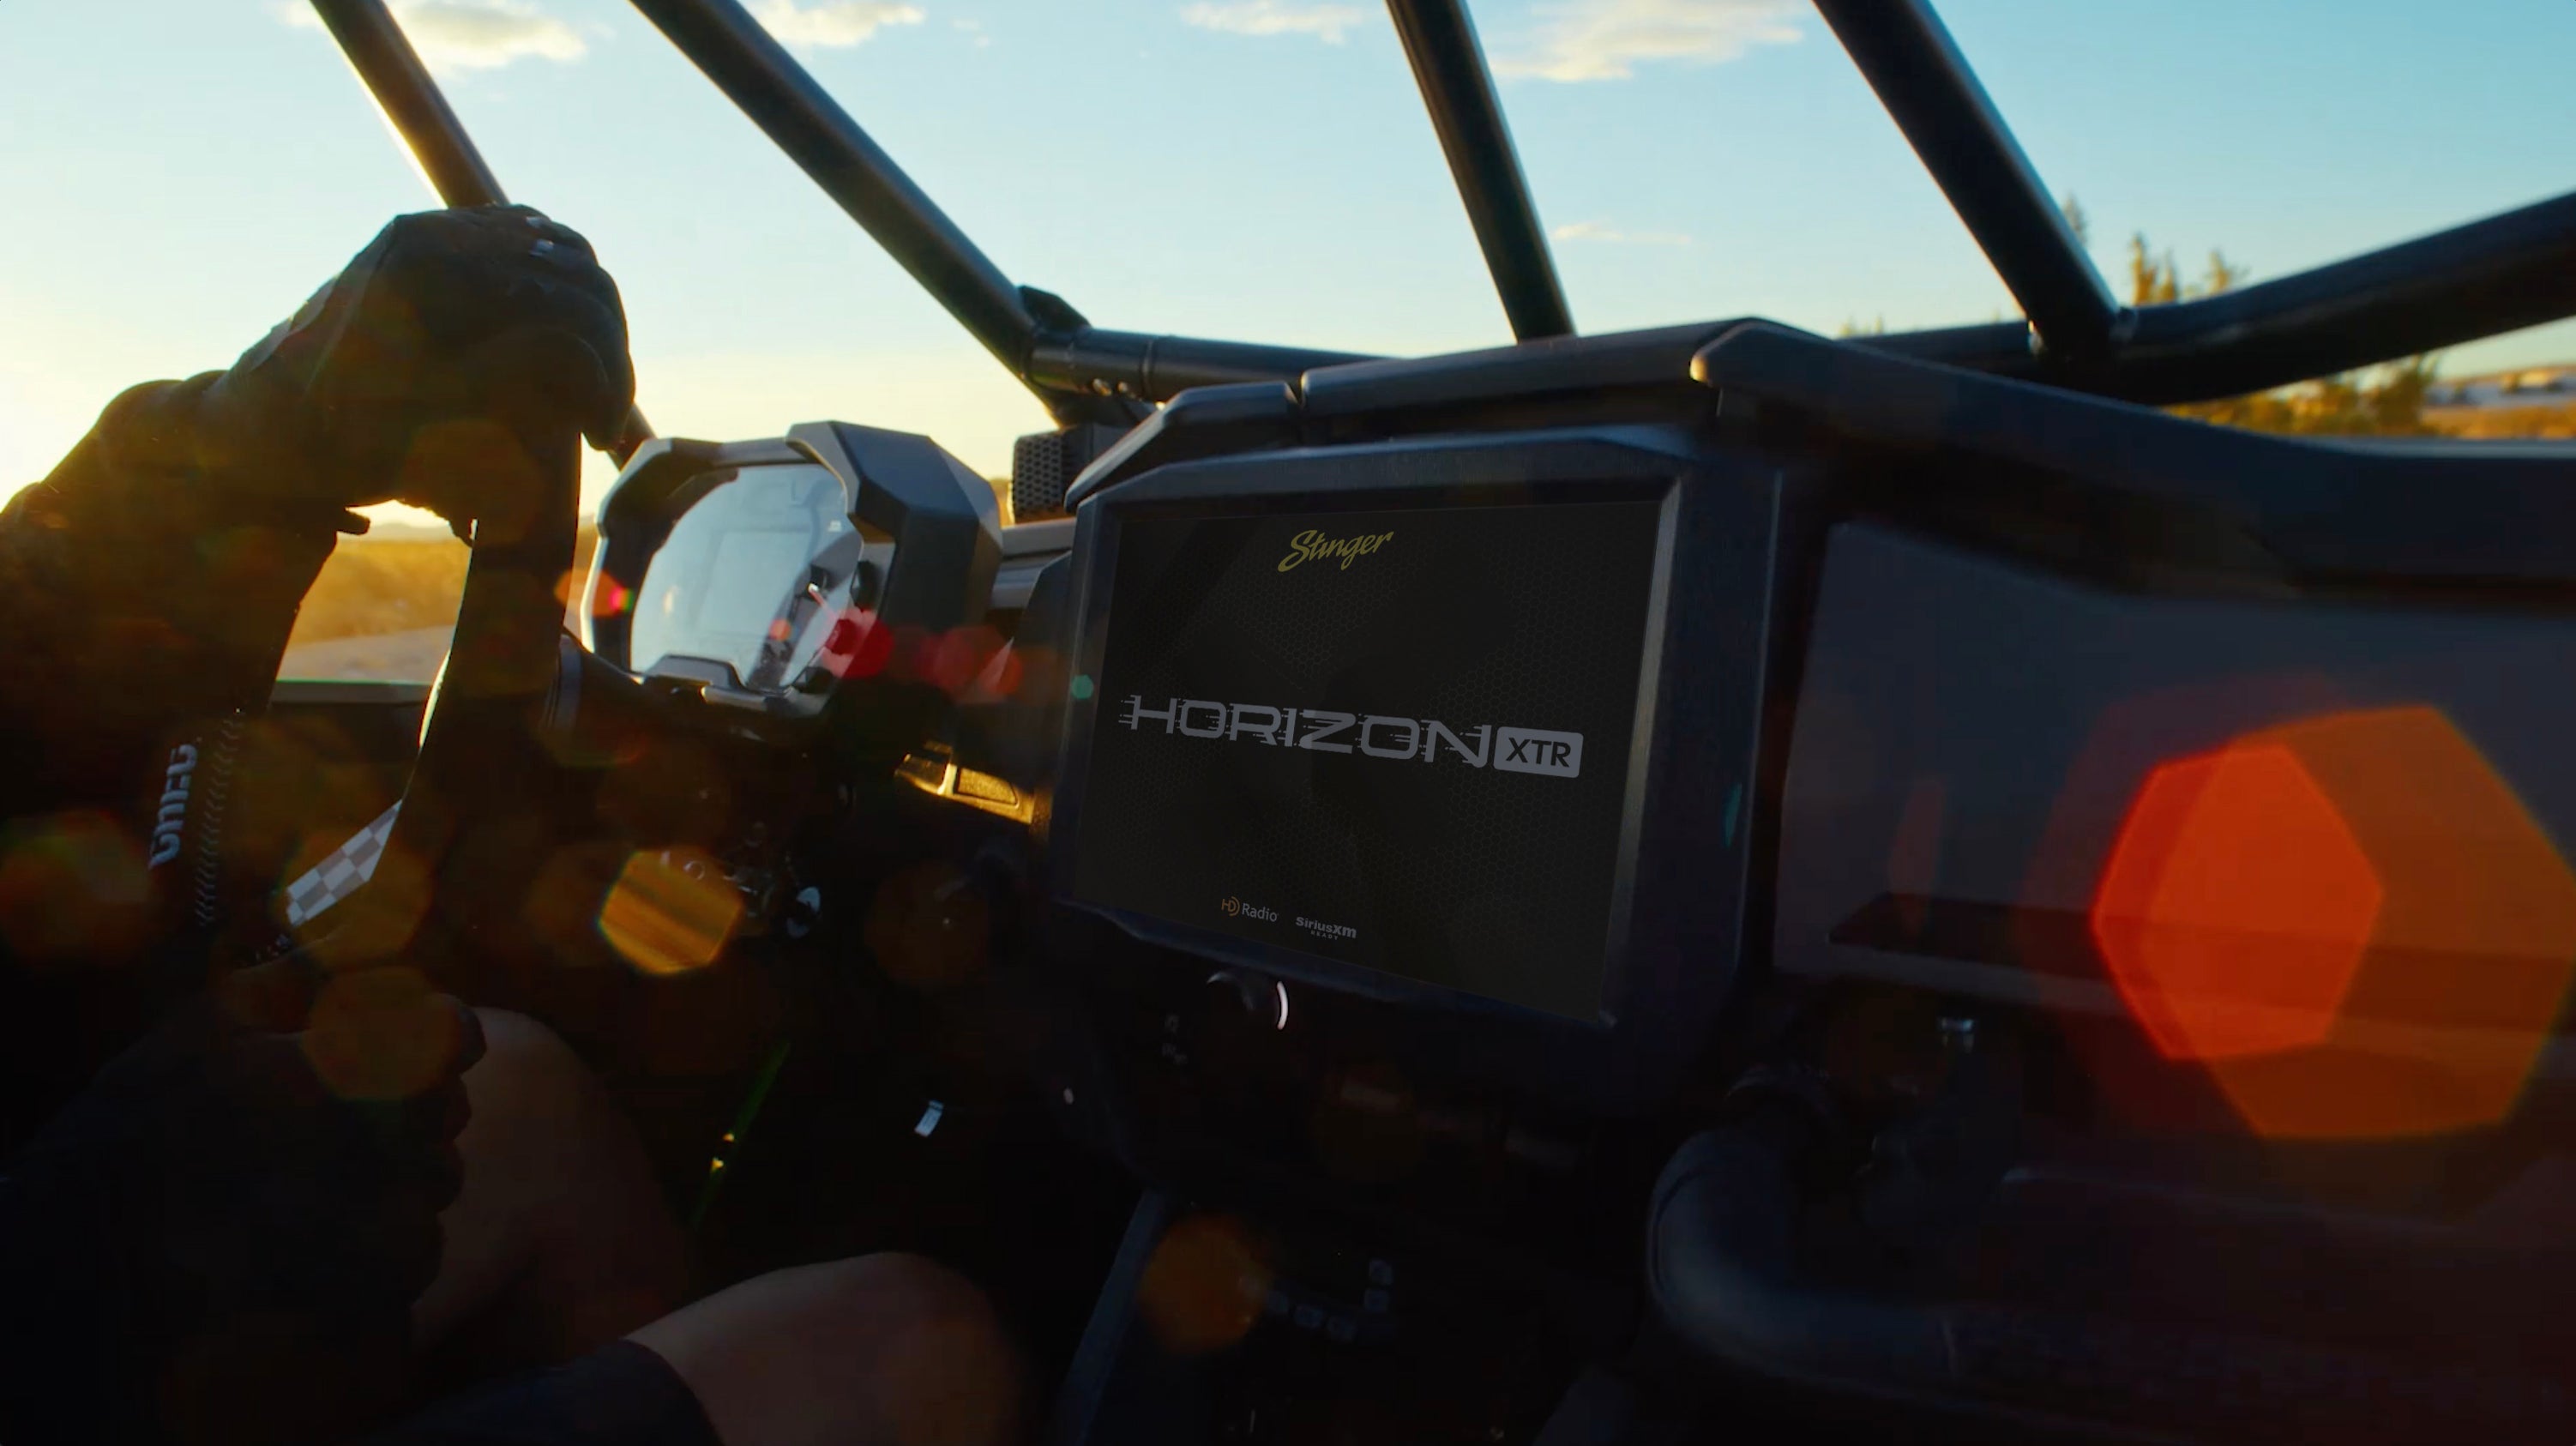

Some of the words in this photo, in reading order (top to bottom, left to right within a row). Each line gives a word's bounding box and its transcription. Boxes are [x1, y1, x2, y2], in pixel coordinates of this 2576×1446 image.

[1278, 529, 1394, 573] Stinger
[1119, 695, 1492, 768] HORIZON
[1506, 737, 1572, 768] XTR
[1221, 897, 1238, 914] HD
[1243, 903, 1279, 923] Radio
[1310, 930, 1339, 940] READY
